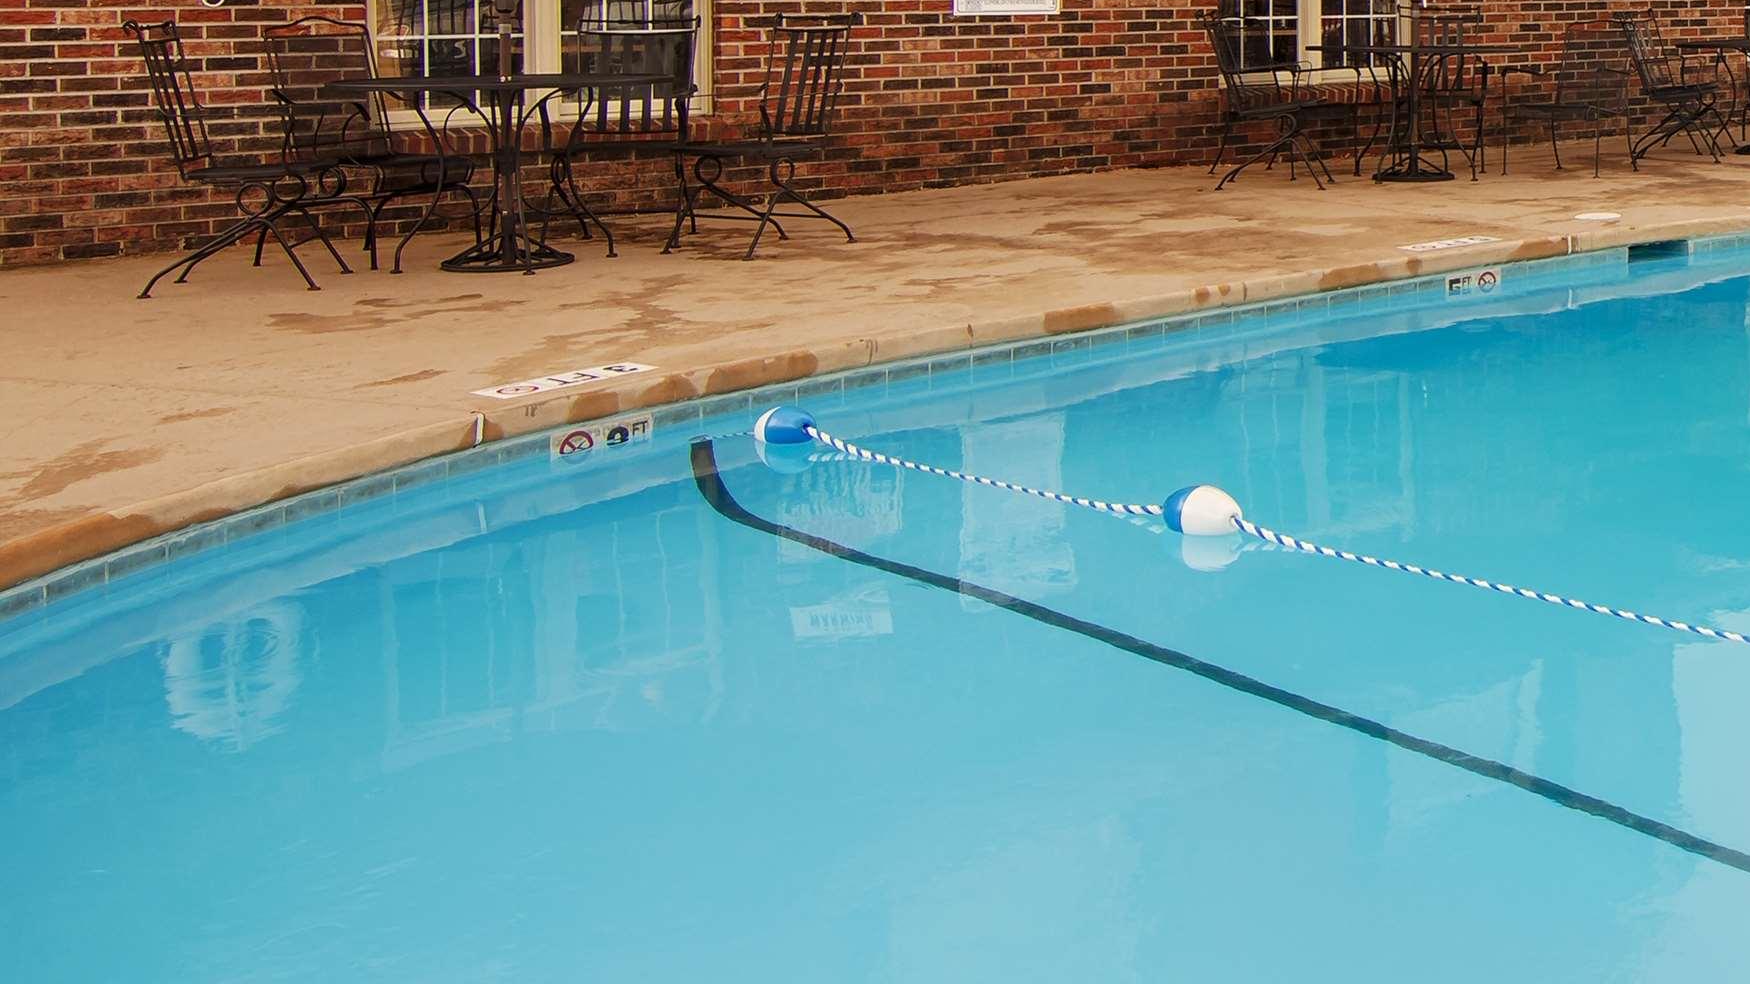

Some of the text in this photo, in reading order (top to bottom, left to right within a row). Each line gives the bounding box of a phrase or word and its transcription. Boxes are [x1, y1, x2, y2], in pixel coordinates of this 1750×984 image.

[1462, 276, 1472, 287] FT
[547, 372, 600, 386] FT
[632, 420, 648, 436] FT
